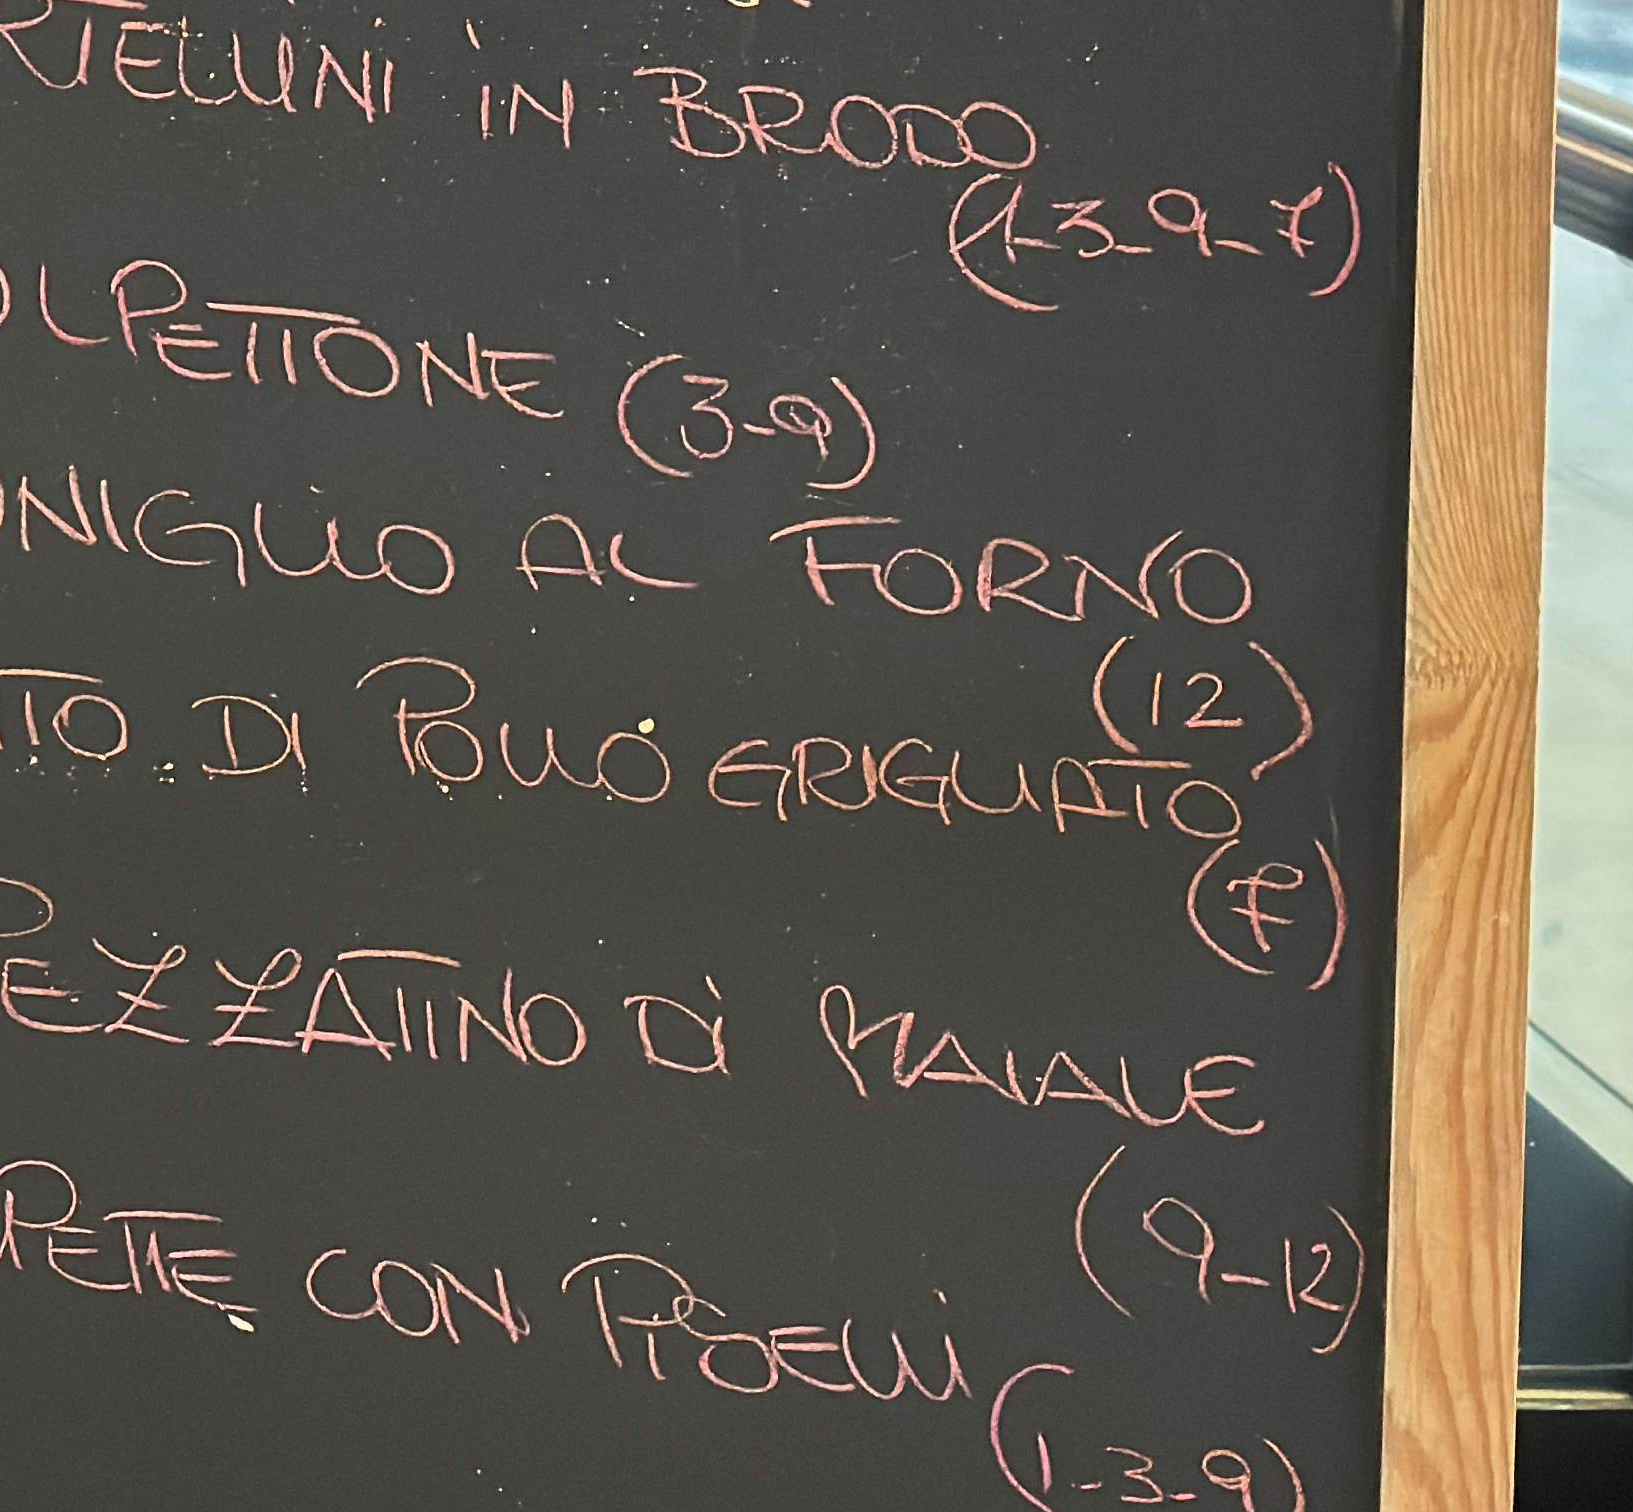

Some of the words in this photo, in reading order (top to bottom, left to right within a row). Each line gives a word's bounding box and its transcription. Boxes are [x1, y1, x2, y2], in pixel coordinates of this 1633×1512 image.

[634, 66, 1036, 169] BRODO
[517, 514, 698, 590] AL
[770, 516, 1252, 624] FORNO
[192, 693, 305, 776] DI
[356, 656, 671, 804] POLLO
[709, 737, 1242, 841] GRIGLIATO
[819, 984, 1266, 1135] MAIALE
[306, 1248, 532, 1344] CON
[562, 1253, 971, 1402] PISELLI
